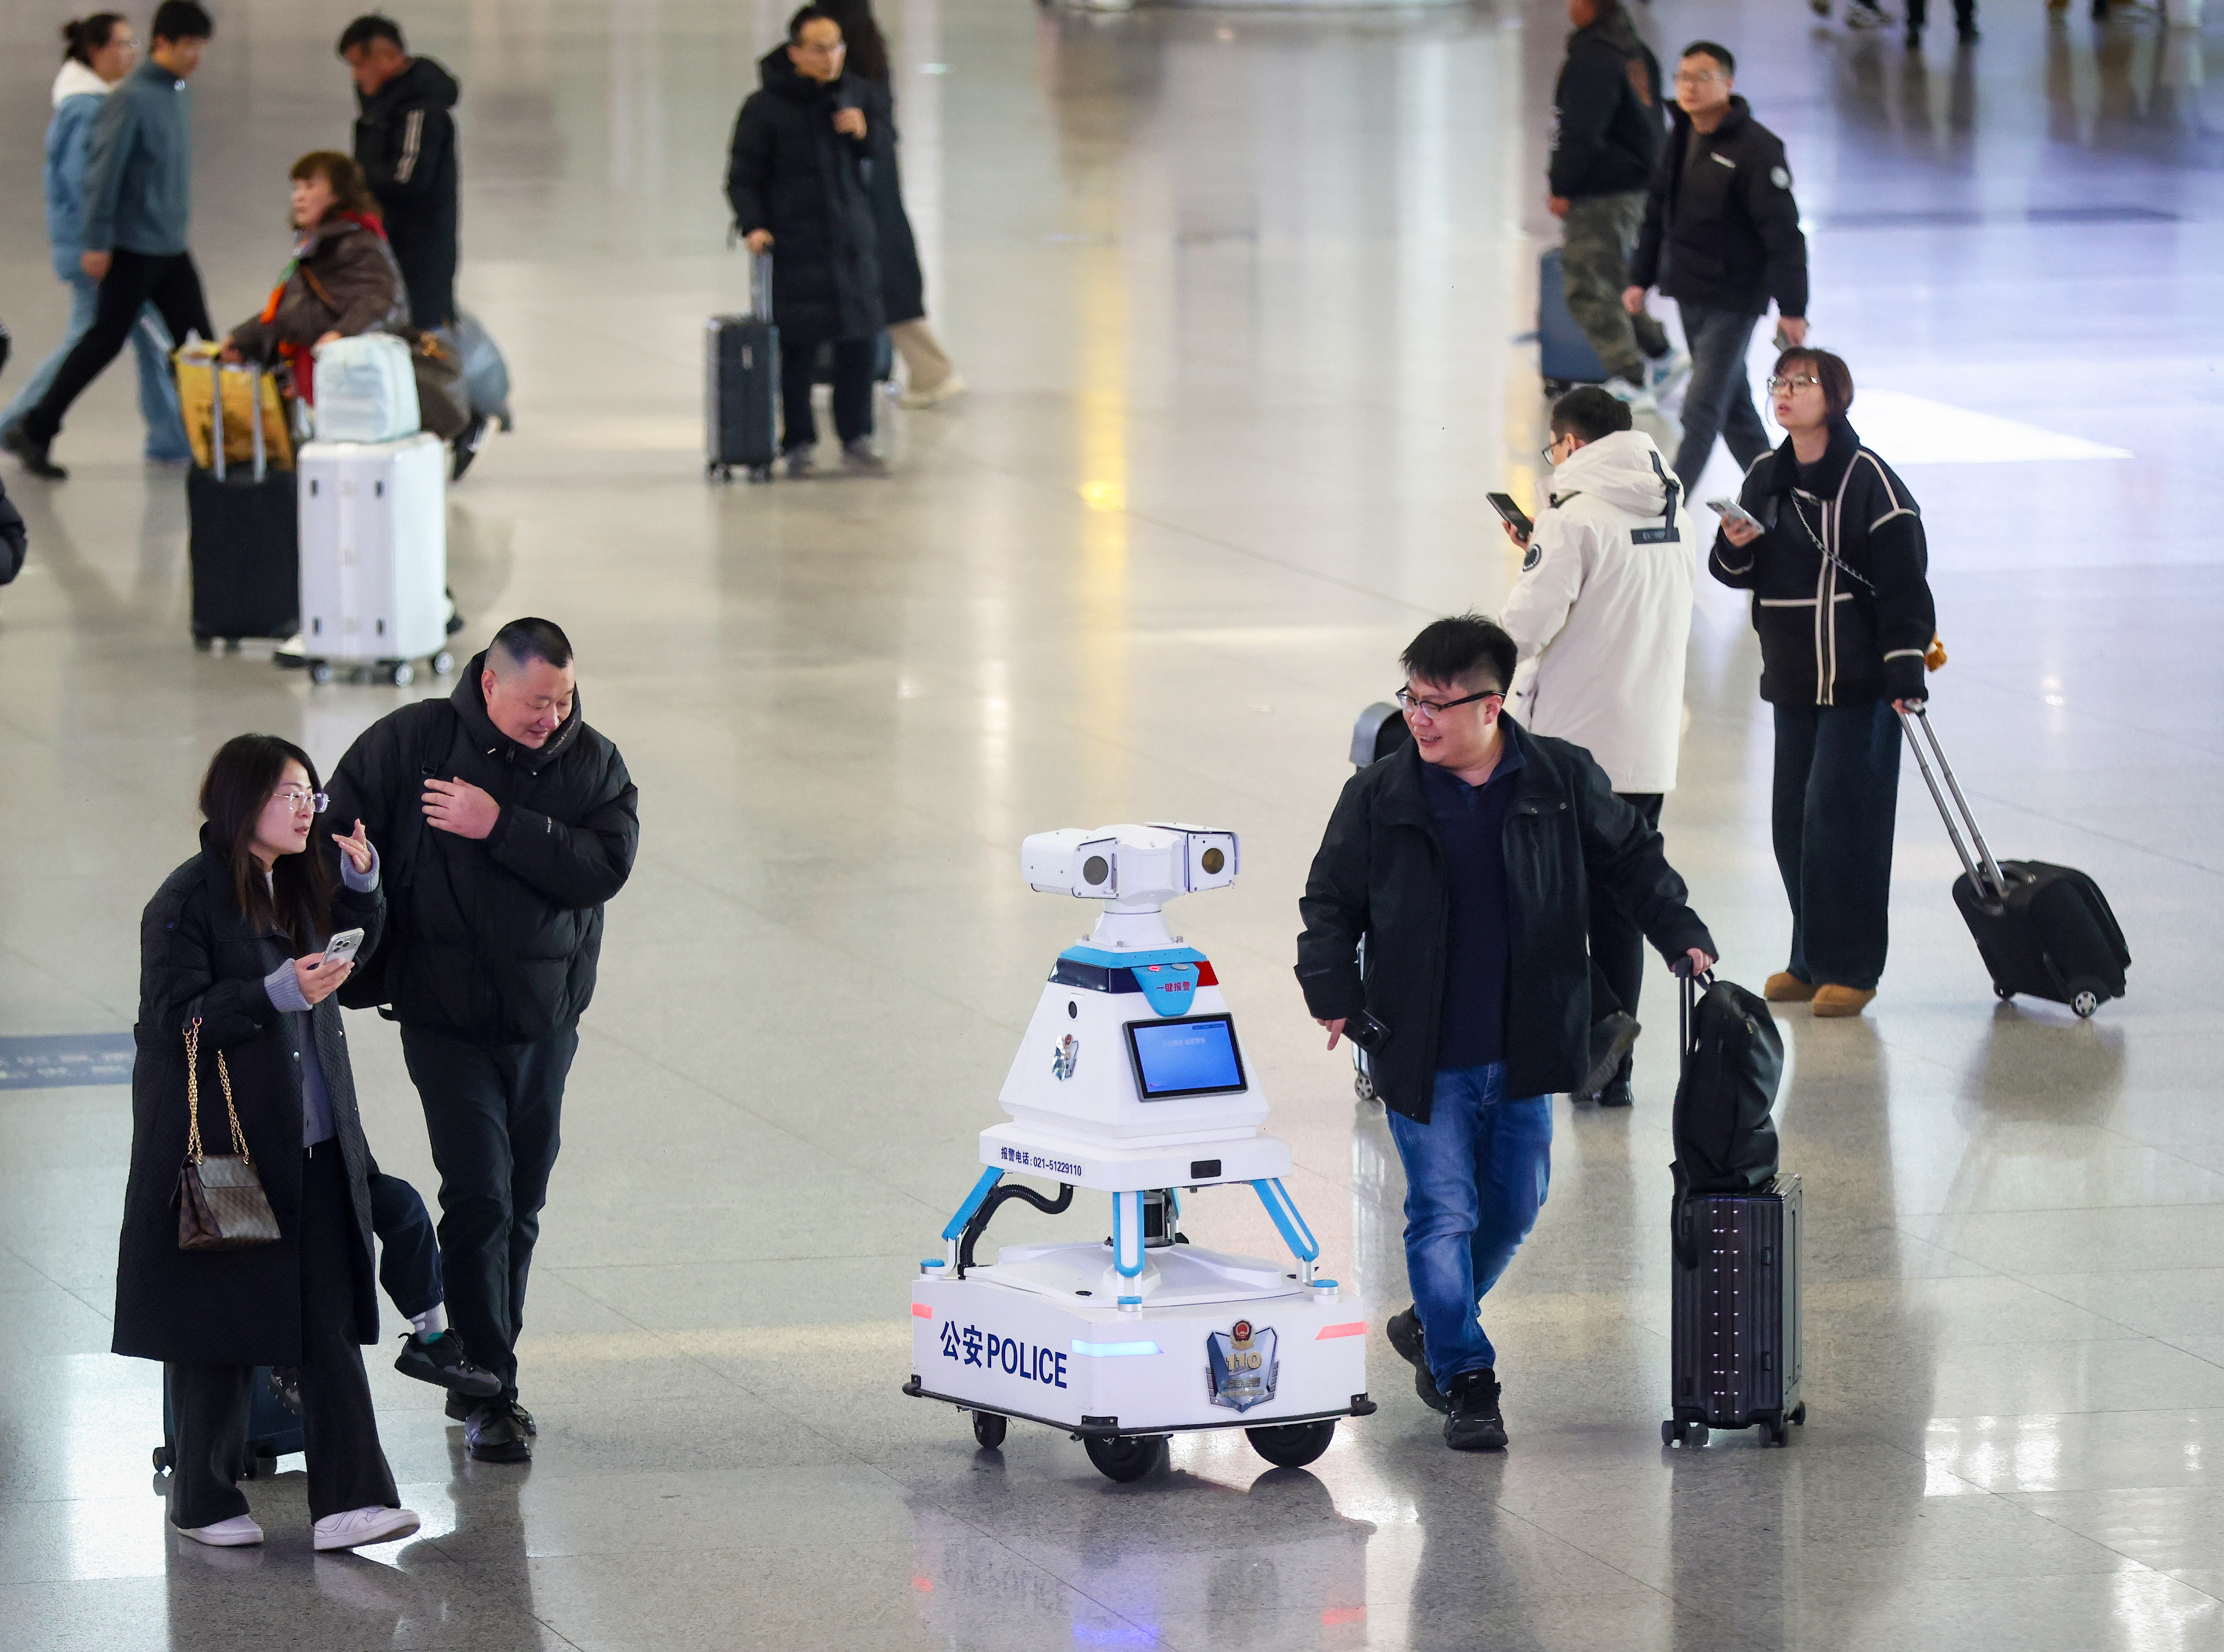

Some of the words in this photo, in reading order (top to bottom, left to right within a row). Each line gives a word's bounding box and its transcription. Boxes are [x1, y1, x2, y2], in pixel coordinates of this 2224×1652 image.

[1156, 982, 1190, 992] 一键报警
[1226, 1352, 1262, 1371] 110
